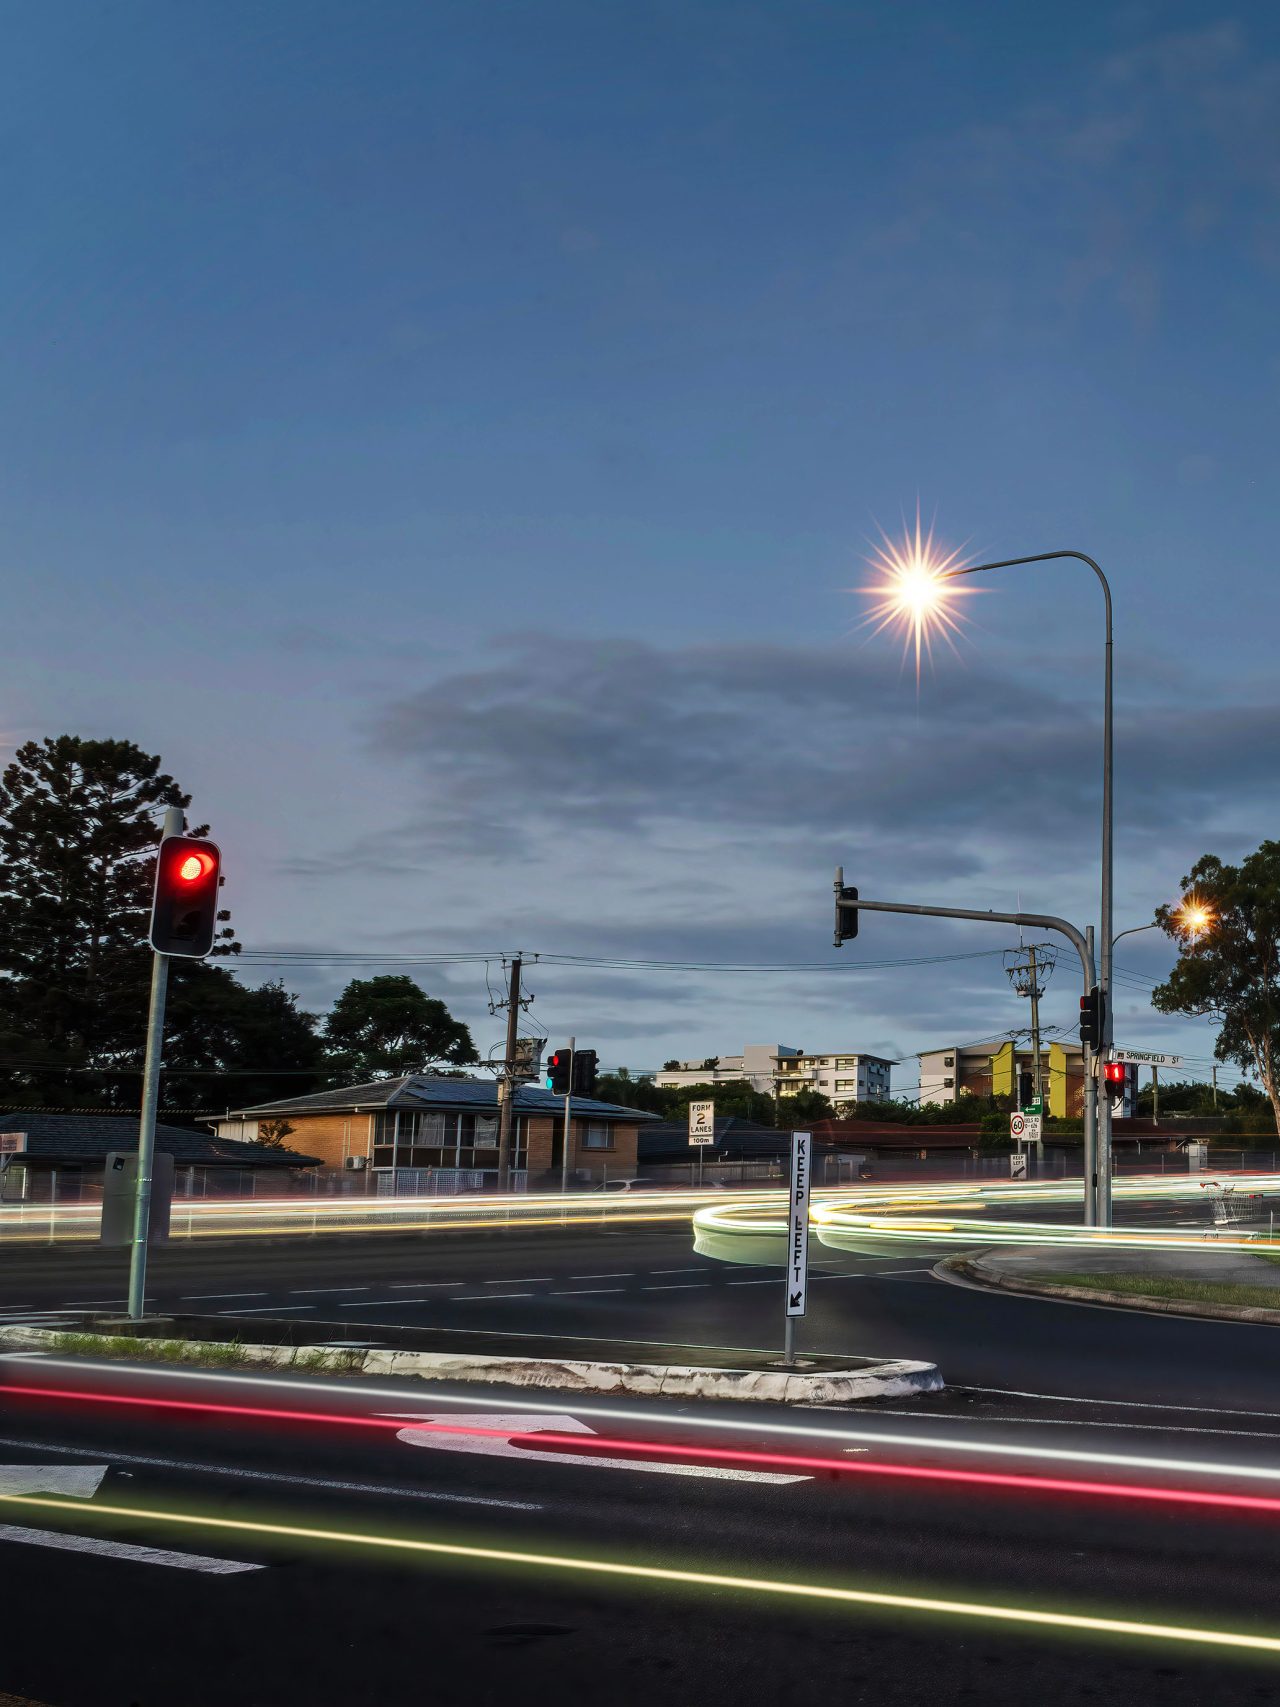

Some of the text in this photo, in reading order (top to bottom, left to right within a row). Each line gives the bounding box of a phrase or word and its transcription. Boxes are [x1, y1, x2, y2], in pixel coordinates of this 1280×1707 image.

[1126, 1051, 1166, 1063] SPRINGFIELD
[692, 1104, 711, 1112] FORM
[696, 1112, 706, 1125] 2
[690, 1125, 712, 1133] LANES
[1013, 1120, 1023, 1130] 60
[793, 1139, 806, 1283] KEEP LEFT
